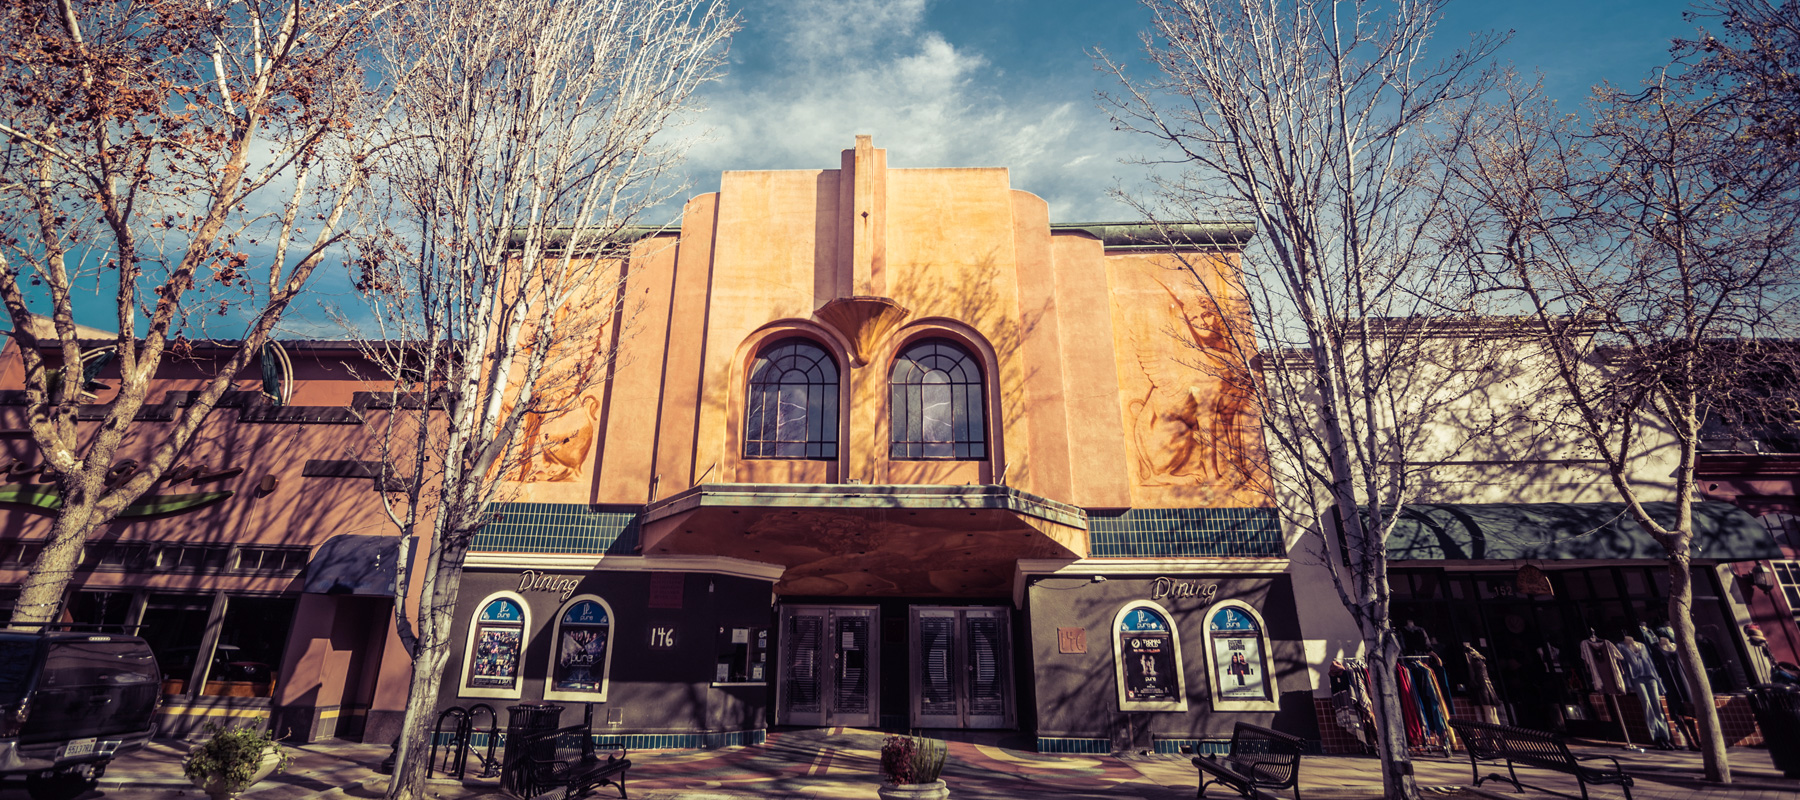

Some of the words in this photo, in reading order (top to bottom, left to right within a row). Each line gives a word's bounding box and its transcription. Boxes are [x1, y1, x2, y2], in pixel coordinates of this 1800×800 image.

[518, 569, 579, 601] Dining
[1153, 576, 1218, 605] Dining
[1493, 585, 1514, 597] 152
[650, 627, 674, 647] 146
[1061, 631, 1084, 651] 146
[570, 653, 594, 664] pure
